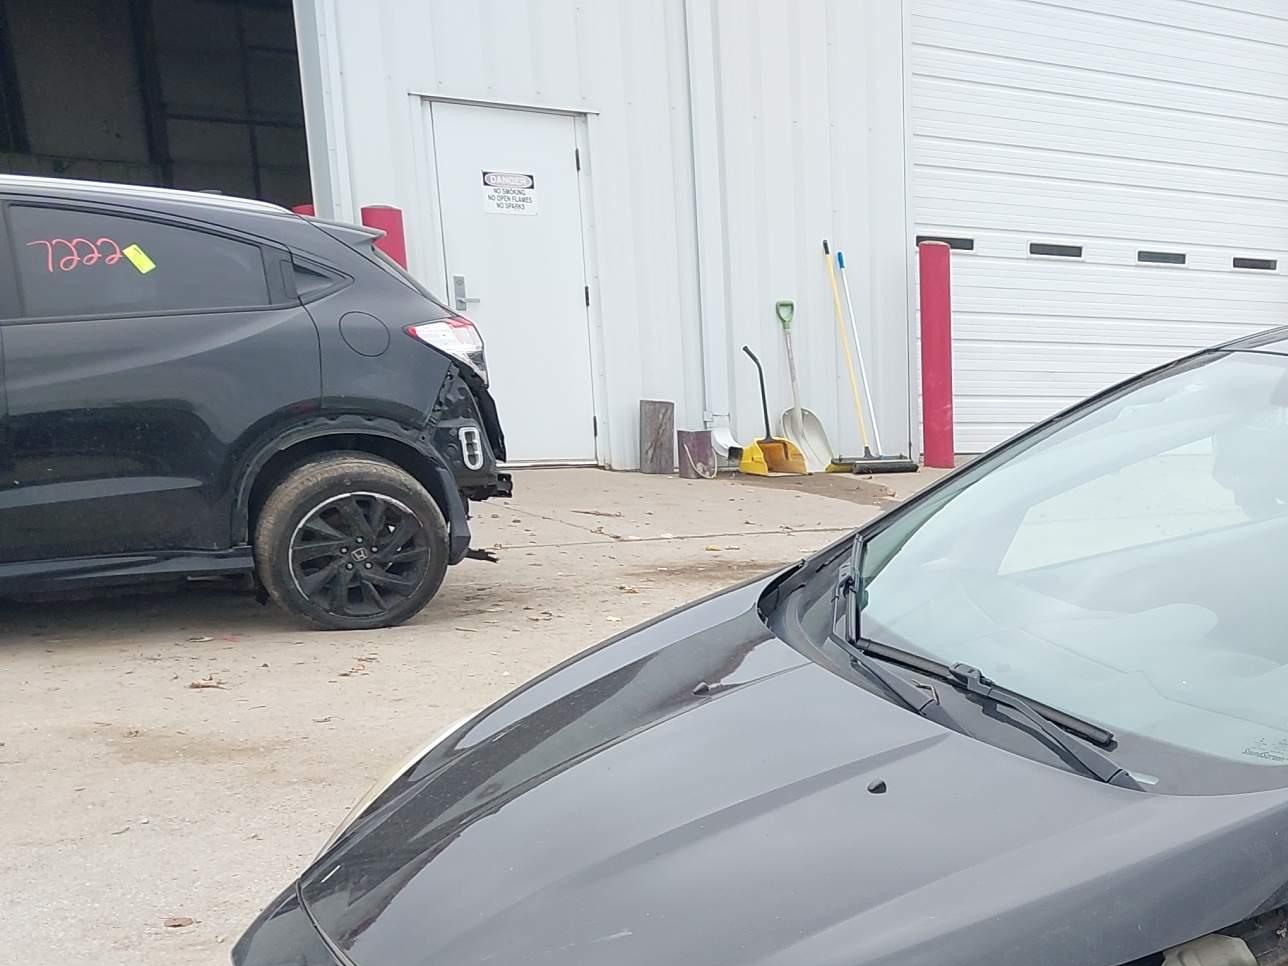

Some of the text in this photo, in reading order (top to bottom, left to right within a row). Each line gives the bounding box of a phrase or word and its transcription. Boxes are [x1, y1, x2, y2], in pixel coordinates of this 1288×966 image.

[490, 175, 527, 187] DANGER
[502, 188, 526, 196] SMOKING
[497, 194, 511, 202] OPEN
[512, 195, 533, 203] FLAMES
[505, 202, 526, 210] SPARKS
[25, 237, 124, 273] 7222
